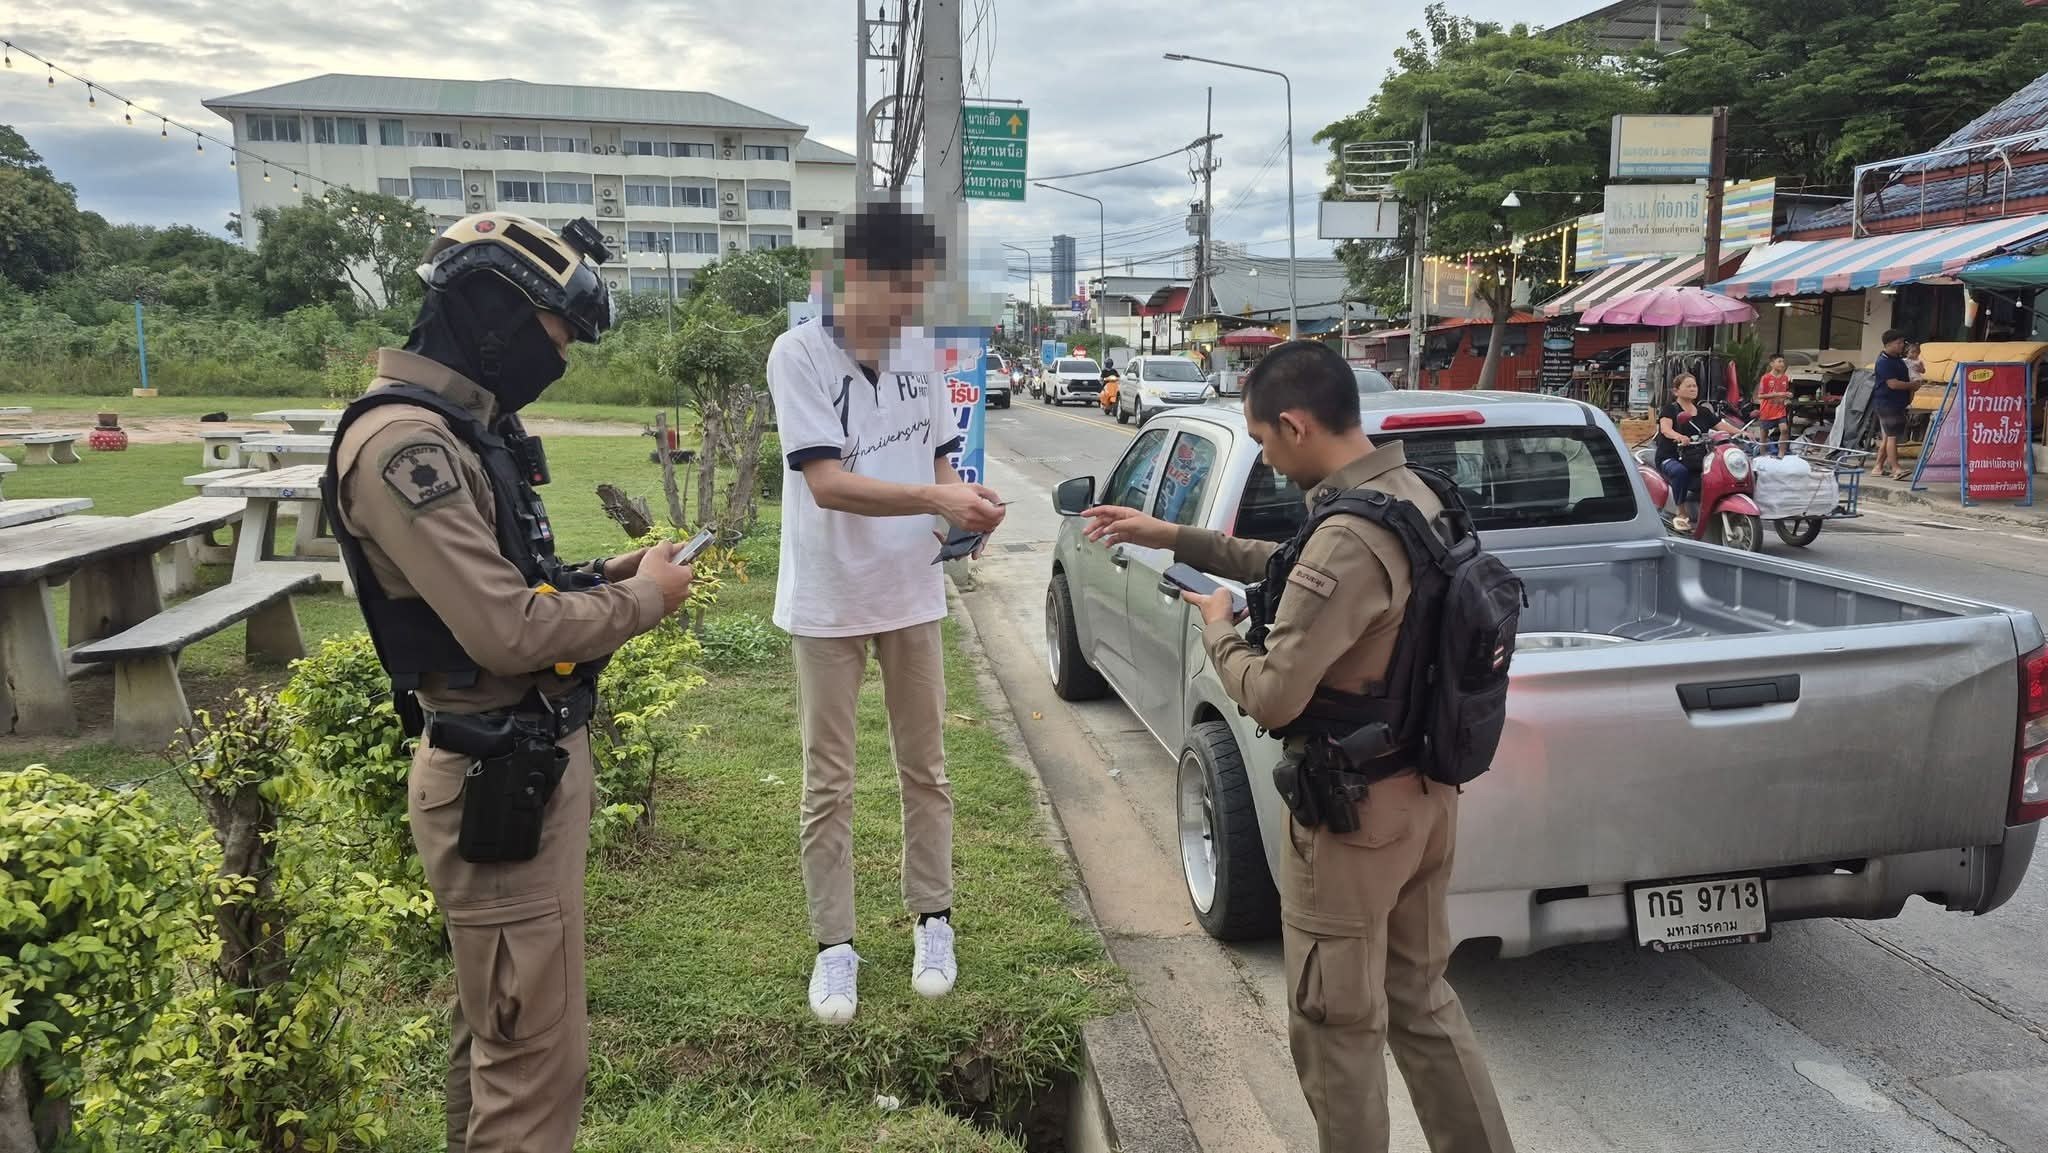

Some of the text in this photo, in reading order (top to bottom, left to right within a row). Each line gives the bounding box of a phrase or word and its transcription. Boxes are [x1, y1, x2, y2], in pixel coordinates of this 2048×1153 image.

[1968, 388, 2022, 412] ข้าวแกง
[1648, 882, 1759, 918] กธ 9713
[1667, 920, 1738, 937] มหาสารคาม
